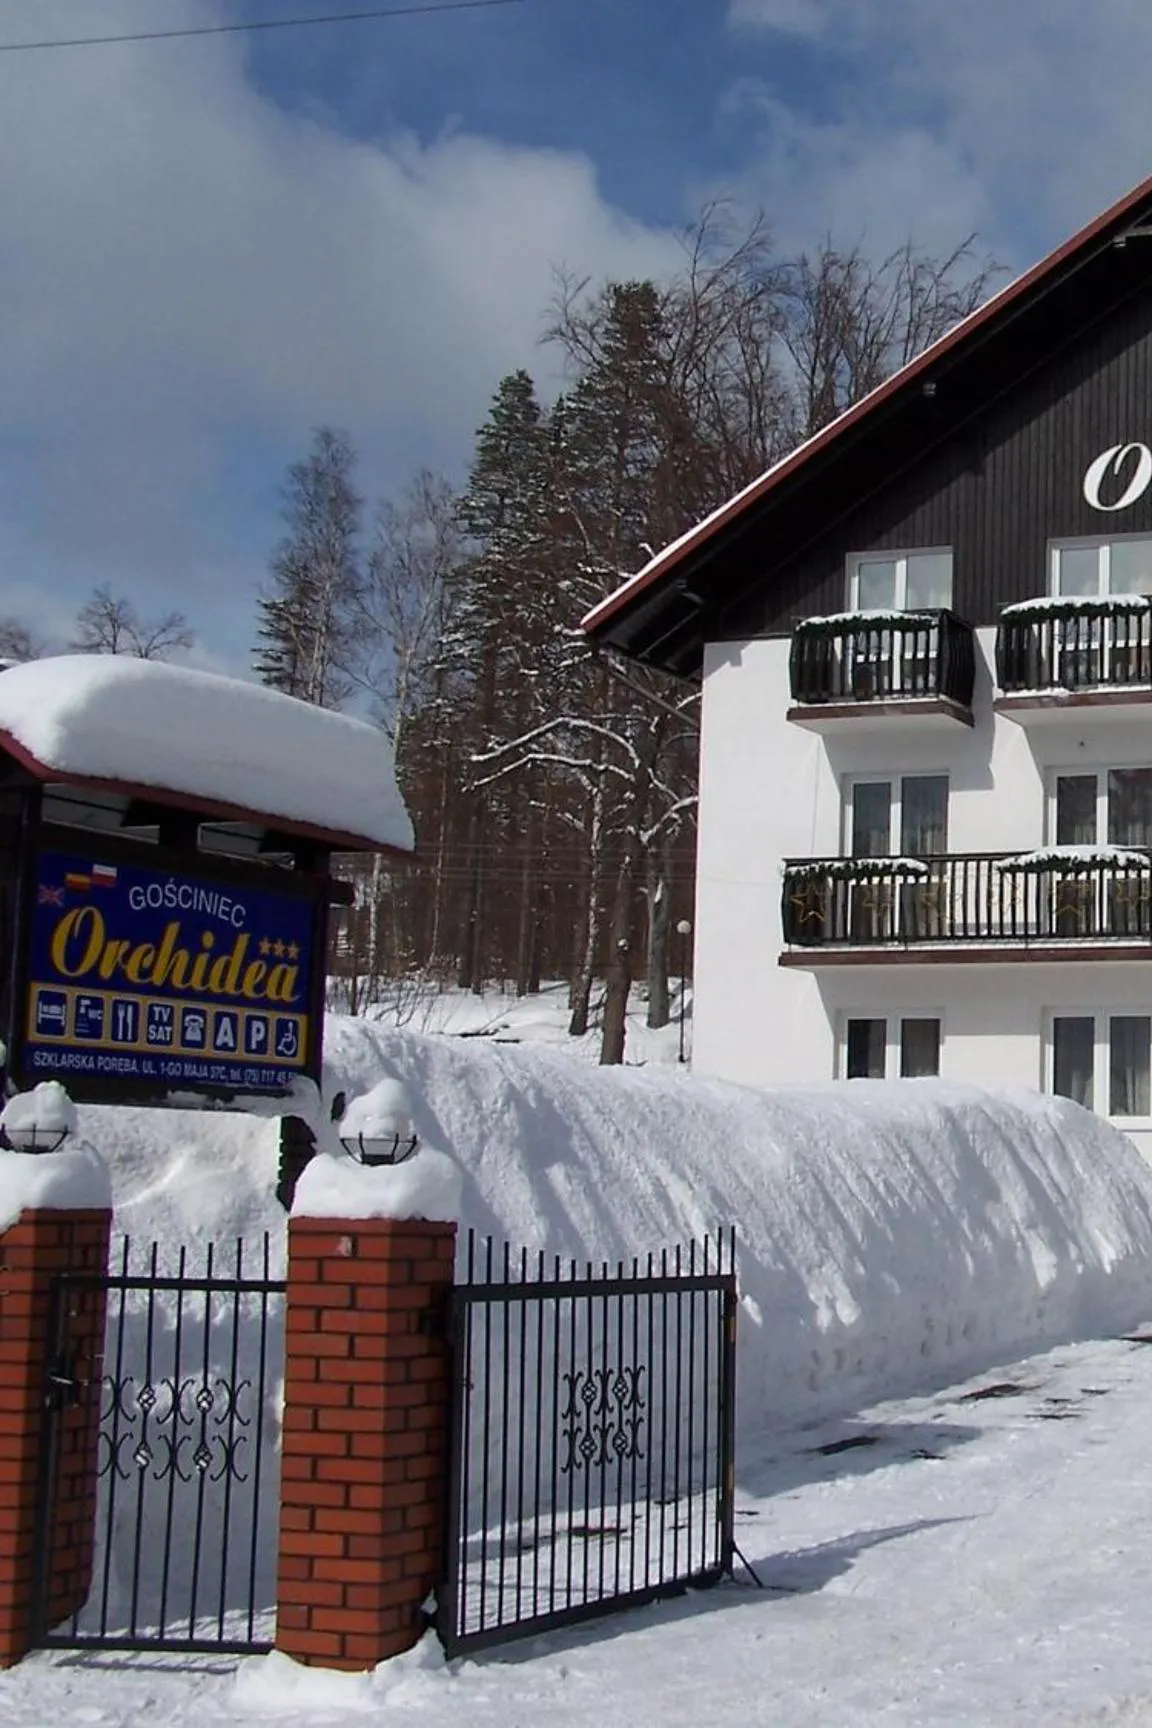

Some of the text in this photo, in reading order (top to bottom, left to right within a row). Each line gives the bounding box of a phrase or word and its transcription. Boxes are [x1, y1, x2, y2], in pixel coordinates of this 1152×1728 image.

[129, 878, 246, 928] GOŚCINIEC
[51, 906, 301, 1002] Orchidea
[88, 1008, 102, 1020] WC
[153, 1005, 171, 1022] TV
[148, 1024, 173, 1041] SAT
[215, 1017, 235, 1047] A
[251, 1019, 266, 1050] P
[33, 1050, 95, 1069] SZKLARSKA
[160, 1062, 181, 1076] 1-GO
[184, 1063, 208, 1078] MAJA
